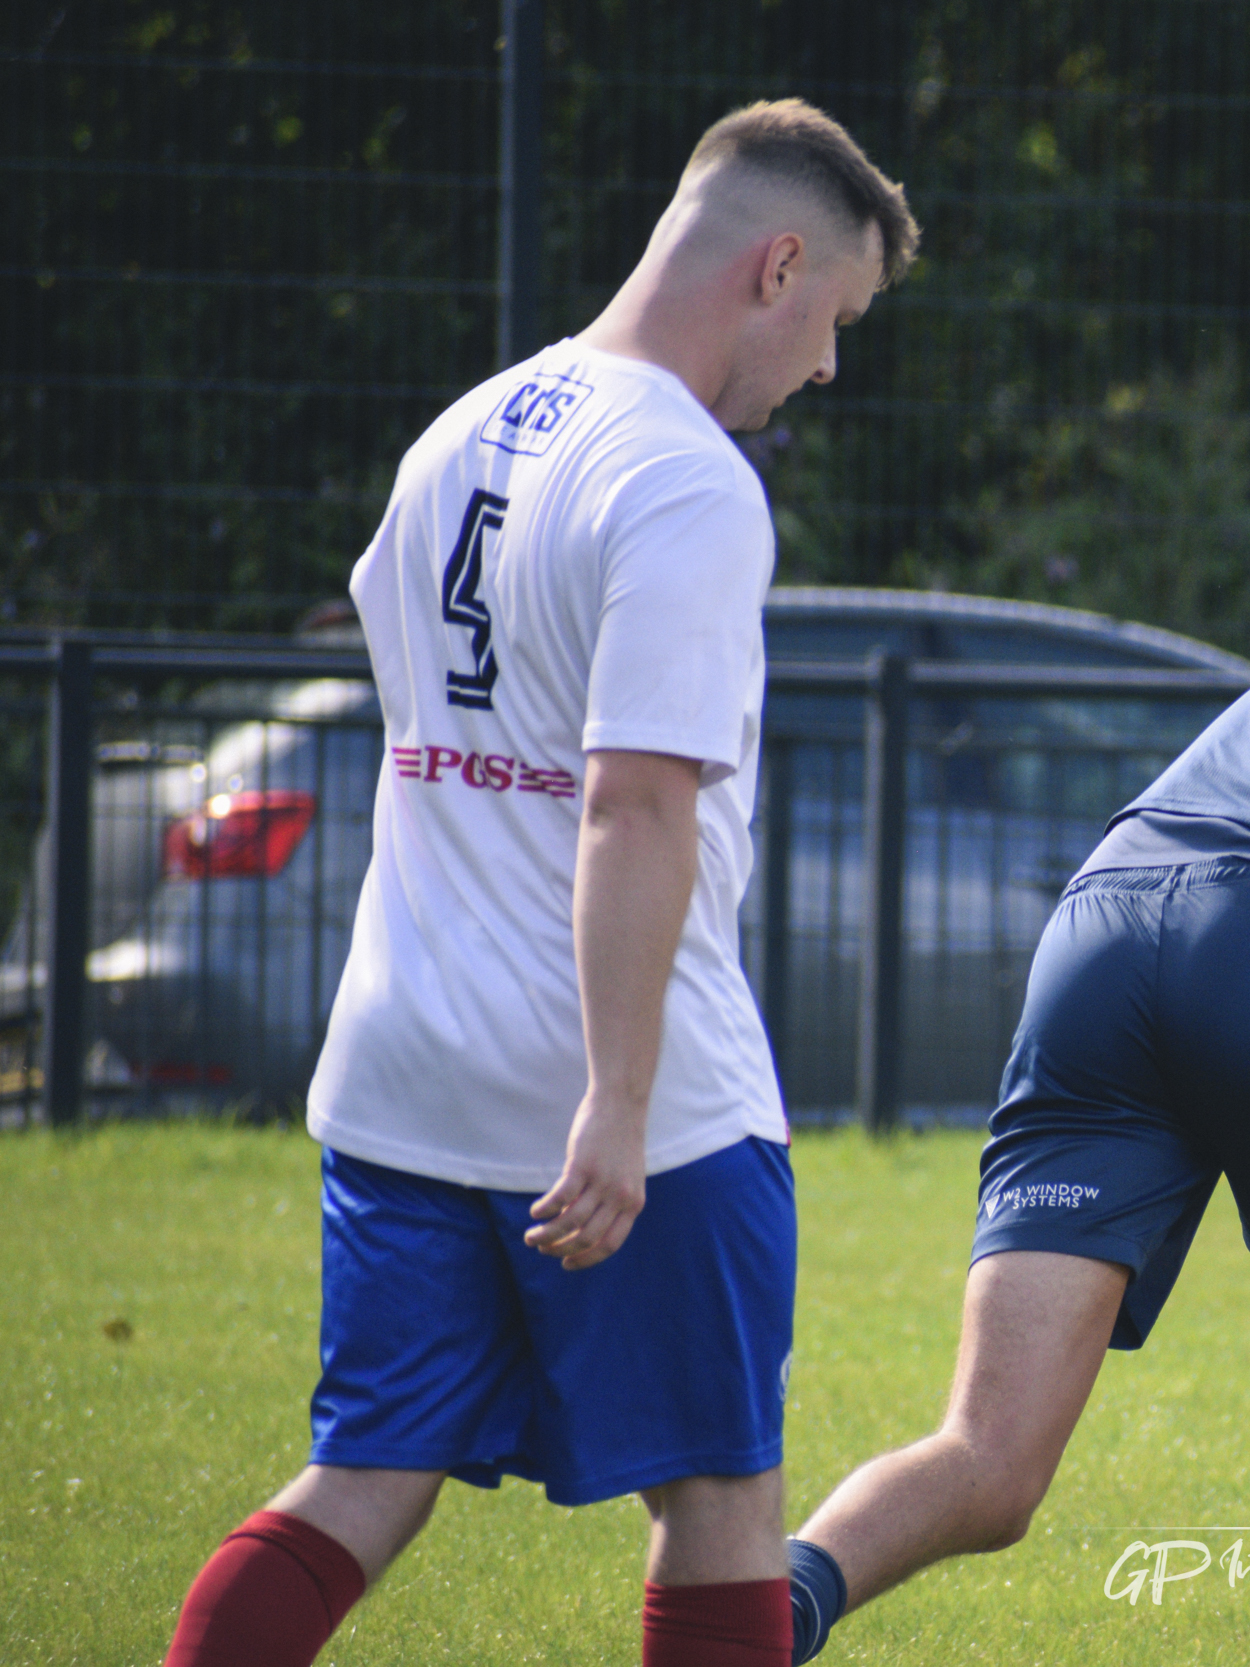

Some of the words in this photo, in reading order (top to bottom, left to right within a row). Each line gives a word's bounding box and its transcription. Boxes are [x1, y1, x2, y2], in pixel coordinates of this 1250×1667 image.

[442, 487, 510, 711] 5
[424, 745, 515, 792] PGS
[1012, 1195, 1080, 1210] SYSTEMS
[1026, 1184, 1100, 1200] WINDOW
